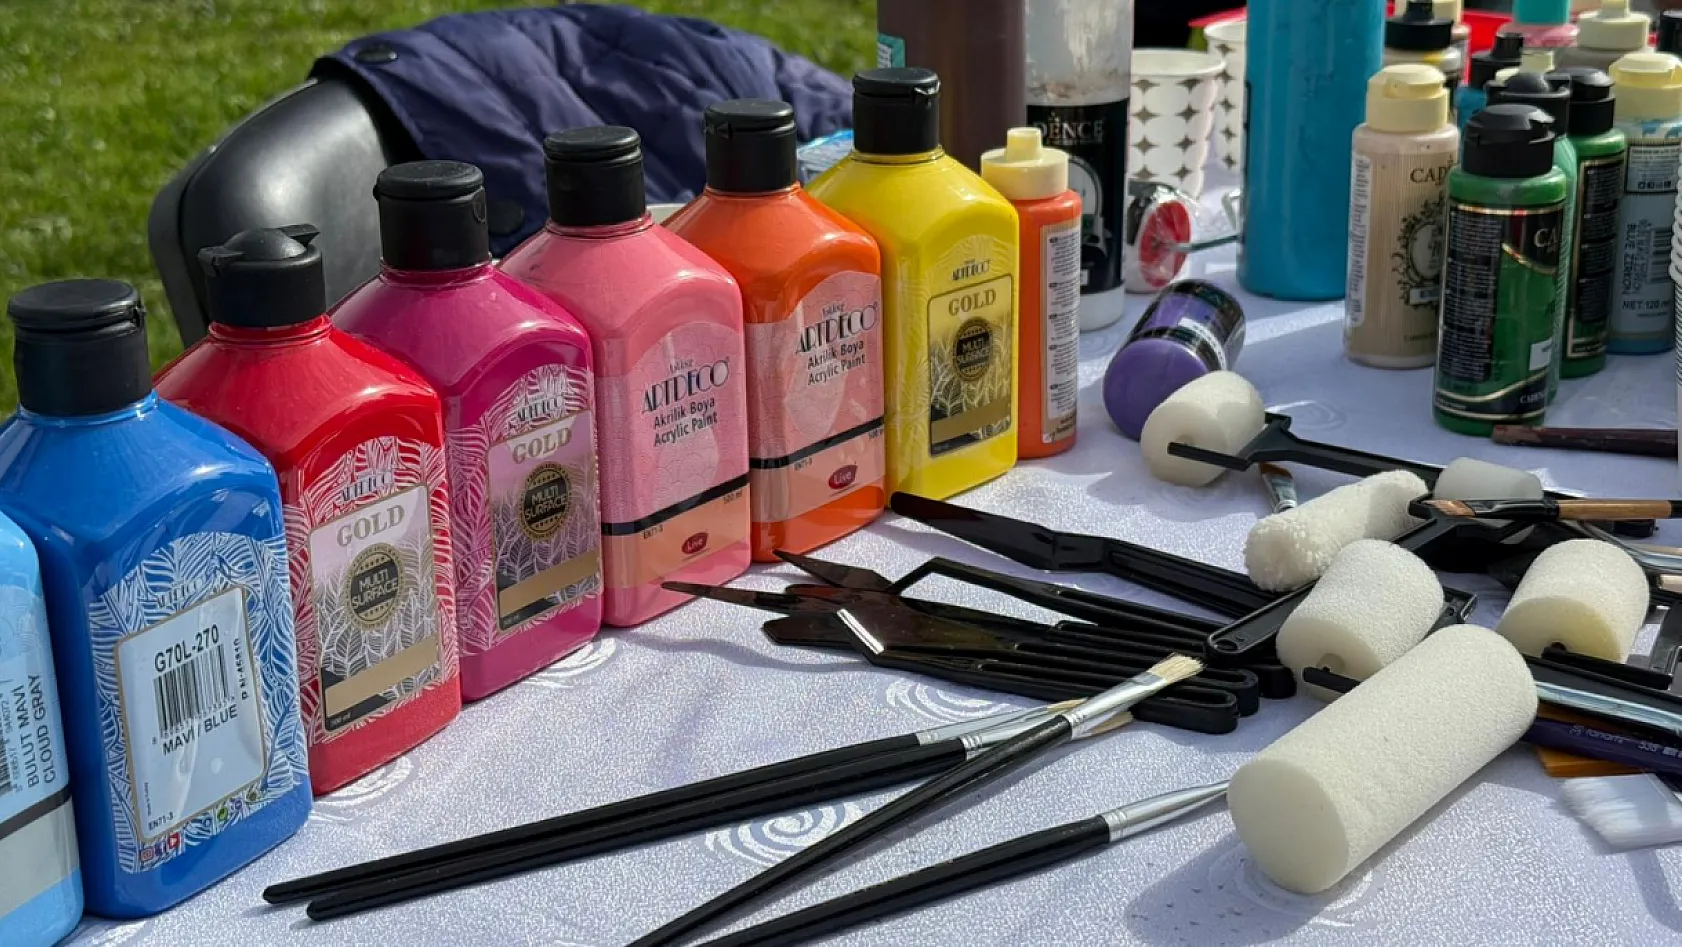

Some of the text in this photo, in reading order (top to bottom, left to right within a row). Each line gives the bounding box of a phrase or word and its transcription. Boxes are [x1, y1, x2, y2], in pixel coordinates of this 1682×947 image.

[1033, 121, 1104, 138] DENCE
[1410, 166, 1448, 185] CAD
[1533, 227, 1558, 248] CA
[948, 288, 997, 316] GOLD
[795, 304, 877, 354] ARTDECO
[807, 340, 864, 370] Akrilik Boya
[807, 354, 866, 386] Acrylic Paint
[641, 360, 730, 414] ARTDECO
[653, 397, 715, 430] Akrilik Boya
[653, 411, 718, 447] Acrylic Paint
[512, 427, 573, 464] GOLD
[832, 471, 853, 485] Live
[524, 492, 568, 520] SURFACE
[531, 485, 559, 507] MULTI
[337, 504, 405, 547] GOLD
[687, 538, 704, 553] Live
[352, 577, 399, 608] SURFACE
[358, 568, 389, 592] MULTI
[154, 624, 219, 672] G70L-270
[28, 674, 56, 784] CLOUD GRAY
[203, 703, 238, 733] BLUE
[20, 731, 40, 789] BULUT
